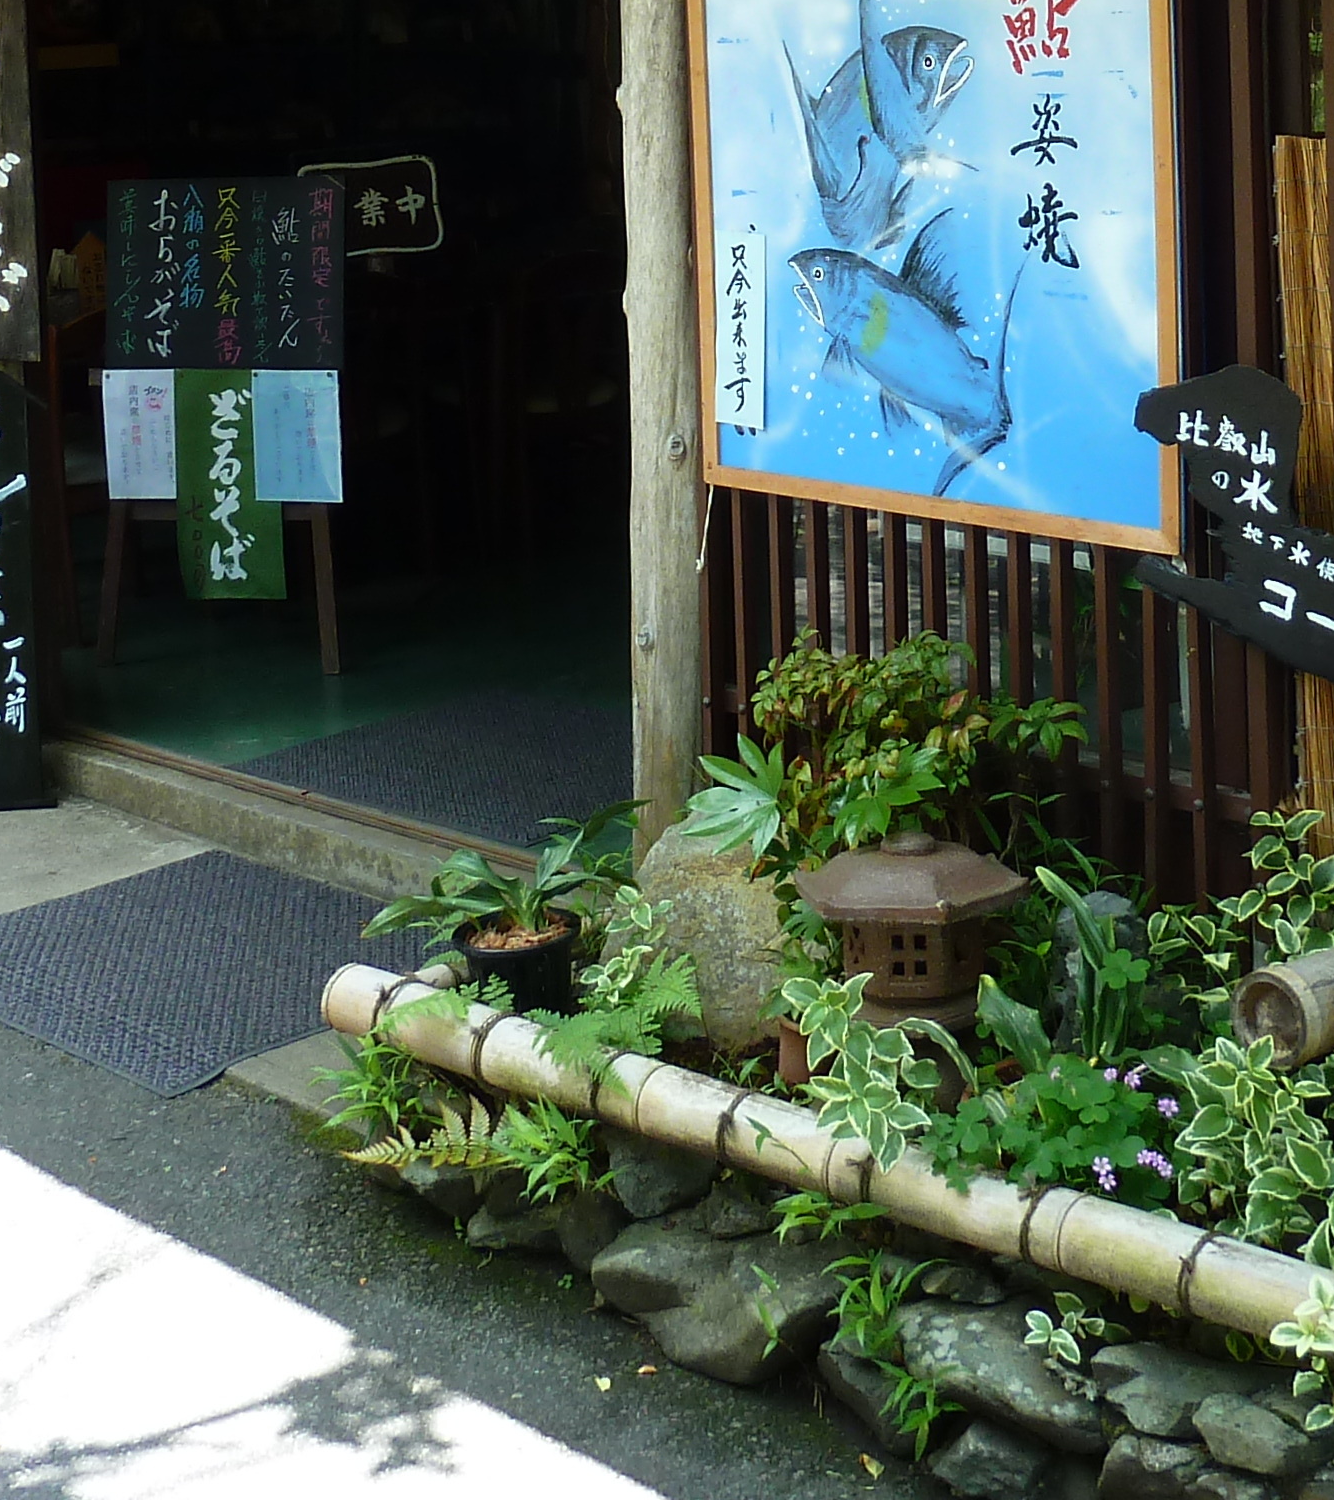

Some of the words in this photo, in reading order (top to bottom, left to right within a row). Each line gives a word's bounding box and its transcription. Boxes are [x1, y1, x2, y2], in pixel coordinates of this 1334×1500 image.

[723, 243, 752, 413] 只今出来ます
[207, 387, 256, 581] ざるそば
[1175, 409, 1277, 466] 比叡山
[1211, 469, 1278, 514] の水
[2, 636, 27, 734] 一人前
